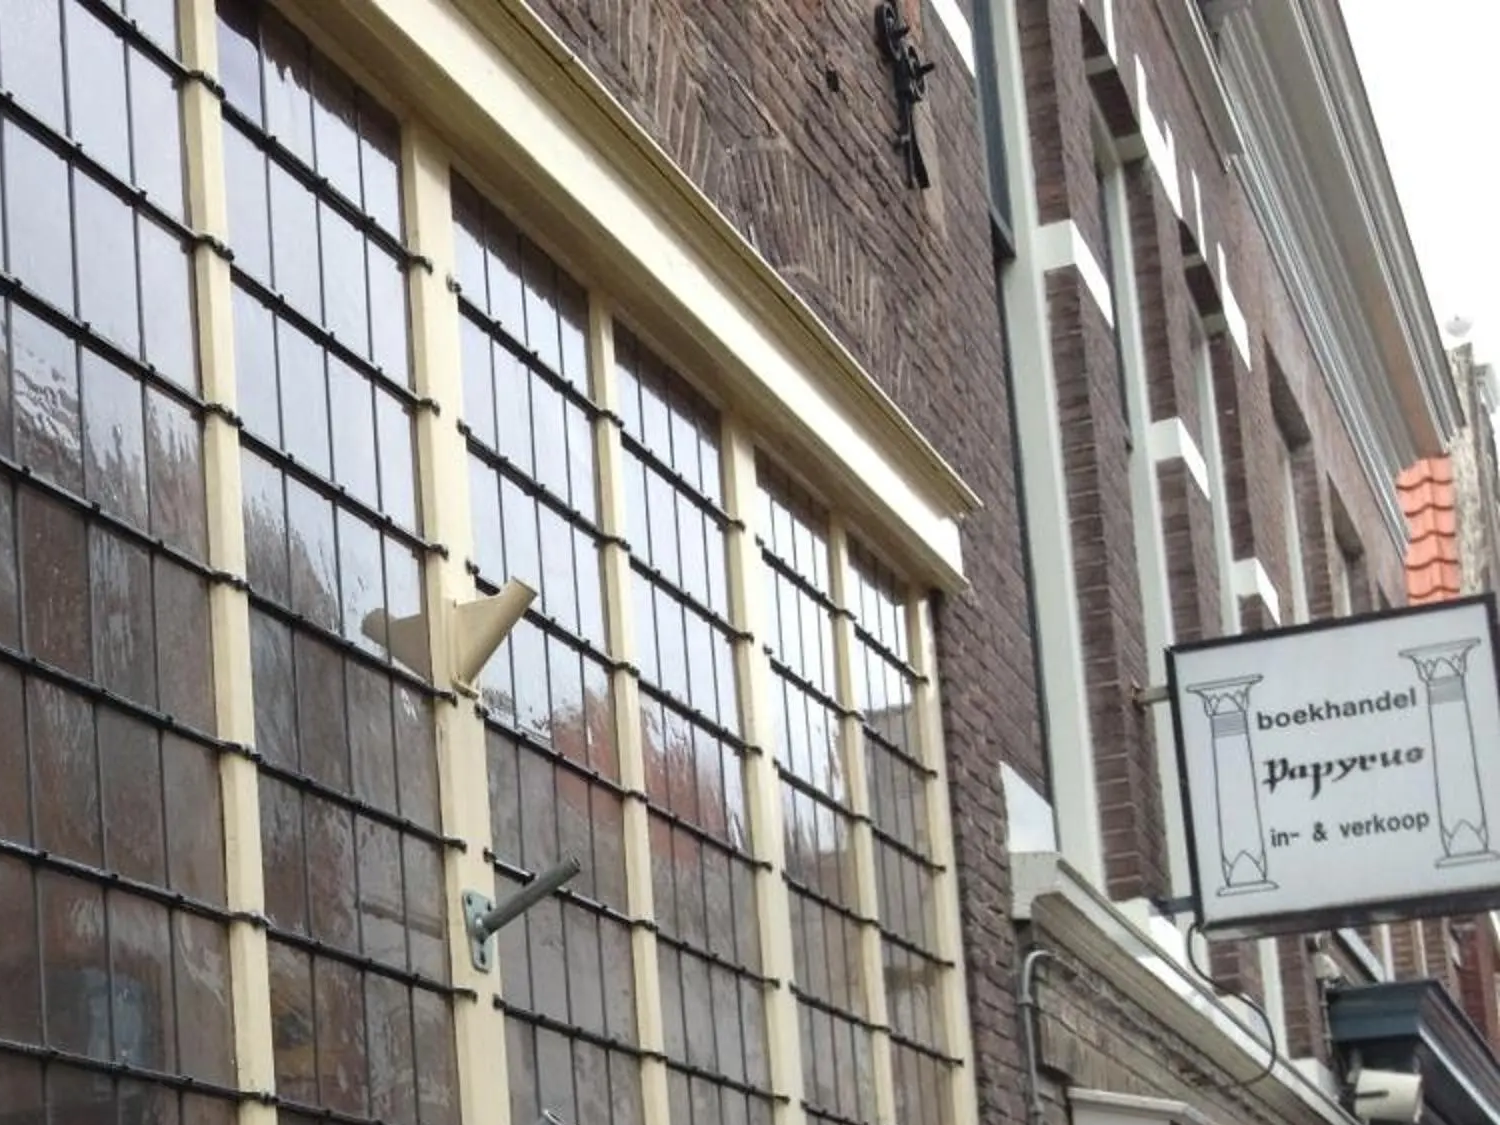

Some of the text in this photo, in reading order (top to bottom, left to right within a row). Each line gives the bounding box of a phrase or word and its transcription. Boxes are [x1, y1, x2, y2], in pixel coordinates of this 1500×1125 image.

[1256, 687, 1418, 731] boekhandel
[1262, 746, 1425, 799] Papyrus
[1269, 811, 1430, 848] in- & verkoop
